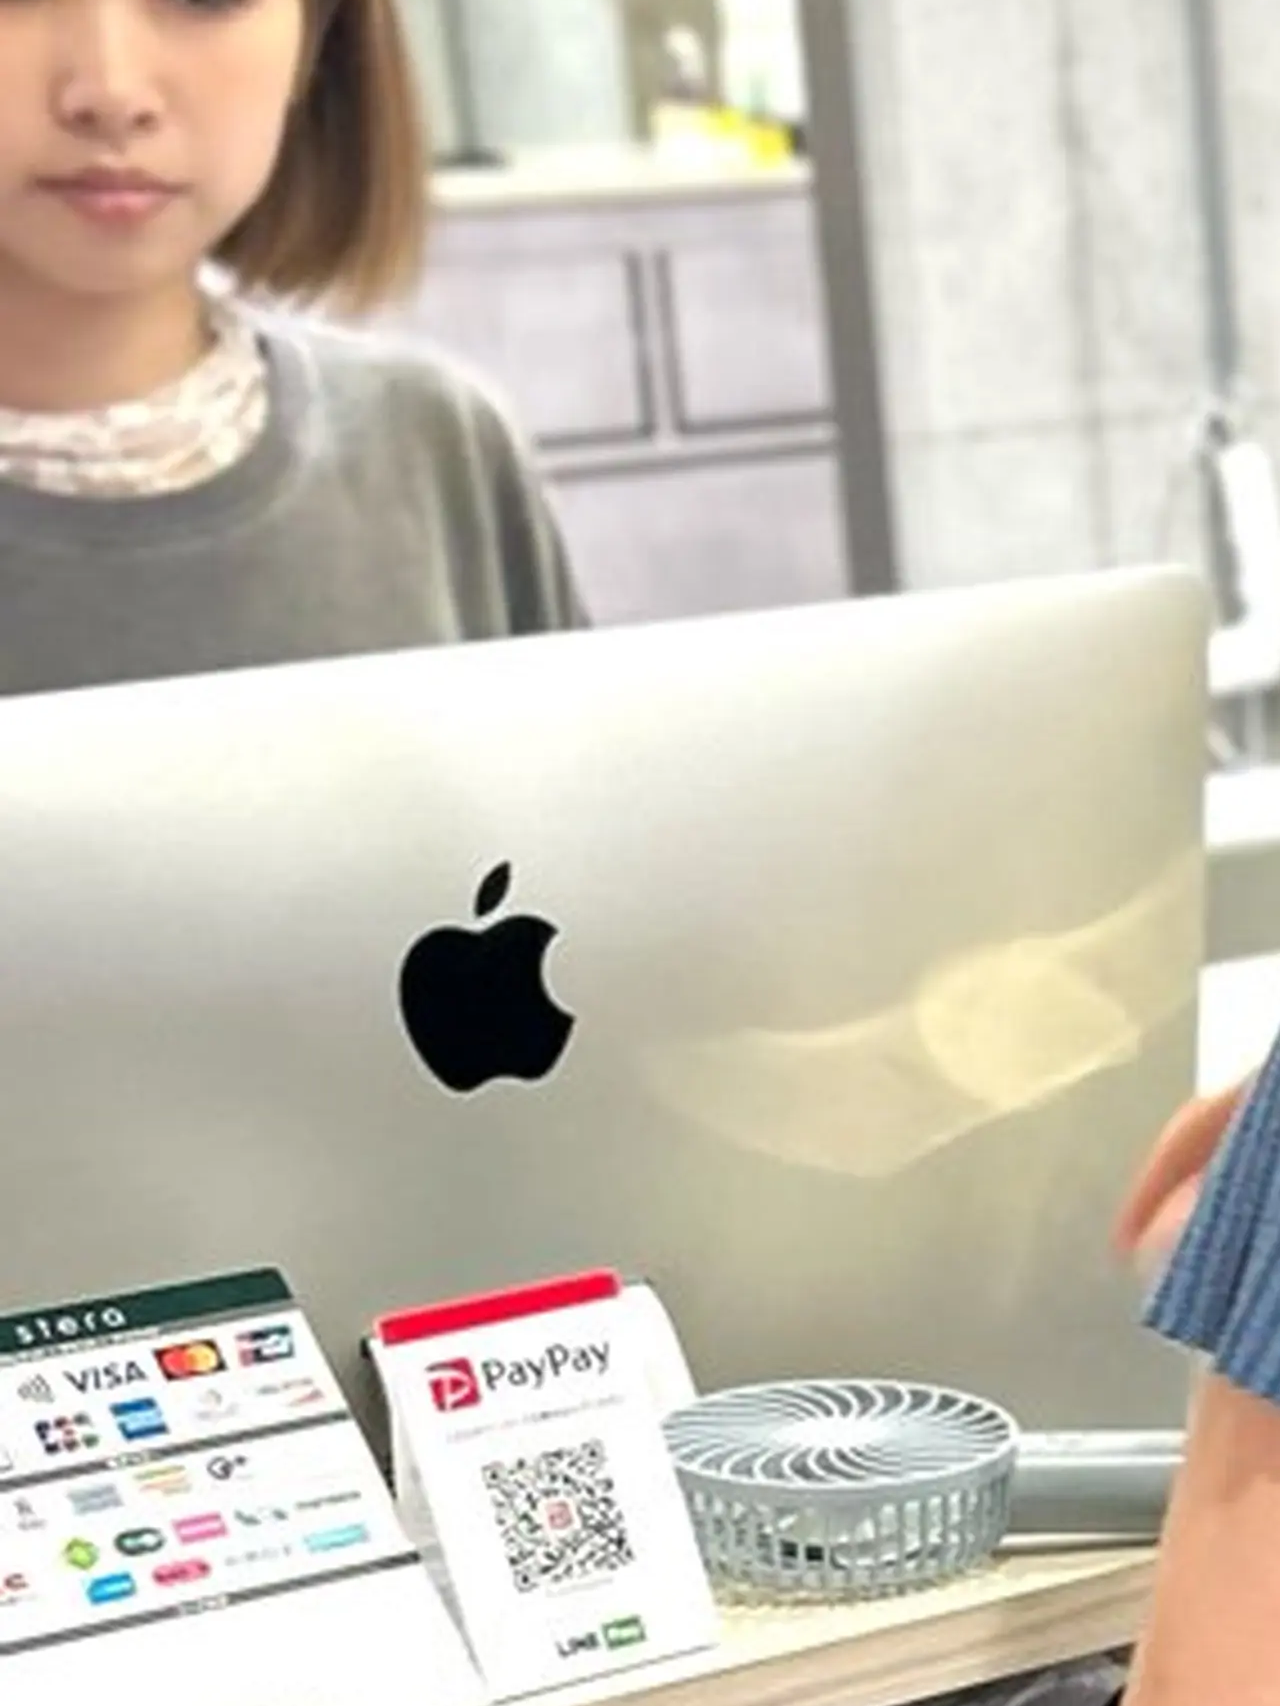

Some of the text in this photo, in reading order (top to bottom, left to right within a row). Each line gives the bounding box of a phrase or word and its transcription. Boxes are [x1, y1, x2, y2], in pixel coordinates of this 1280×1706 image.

[14, 1306, 127, 1345] stera
[63, 1360, 148, 1394] VISA
[481, 1341, 610, 1390] PayPay
